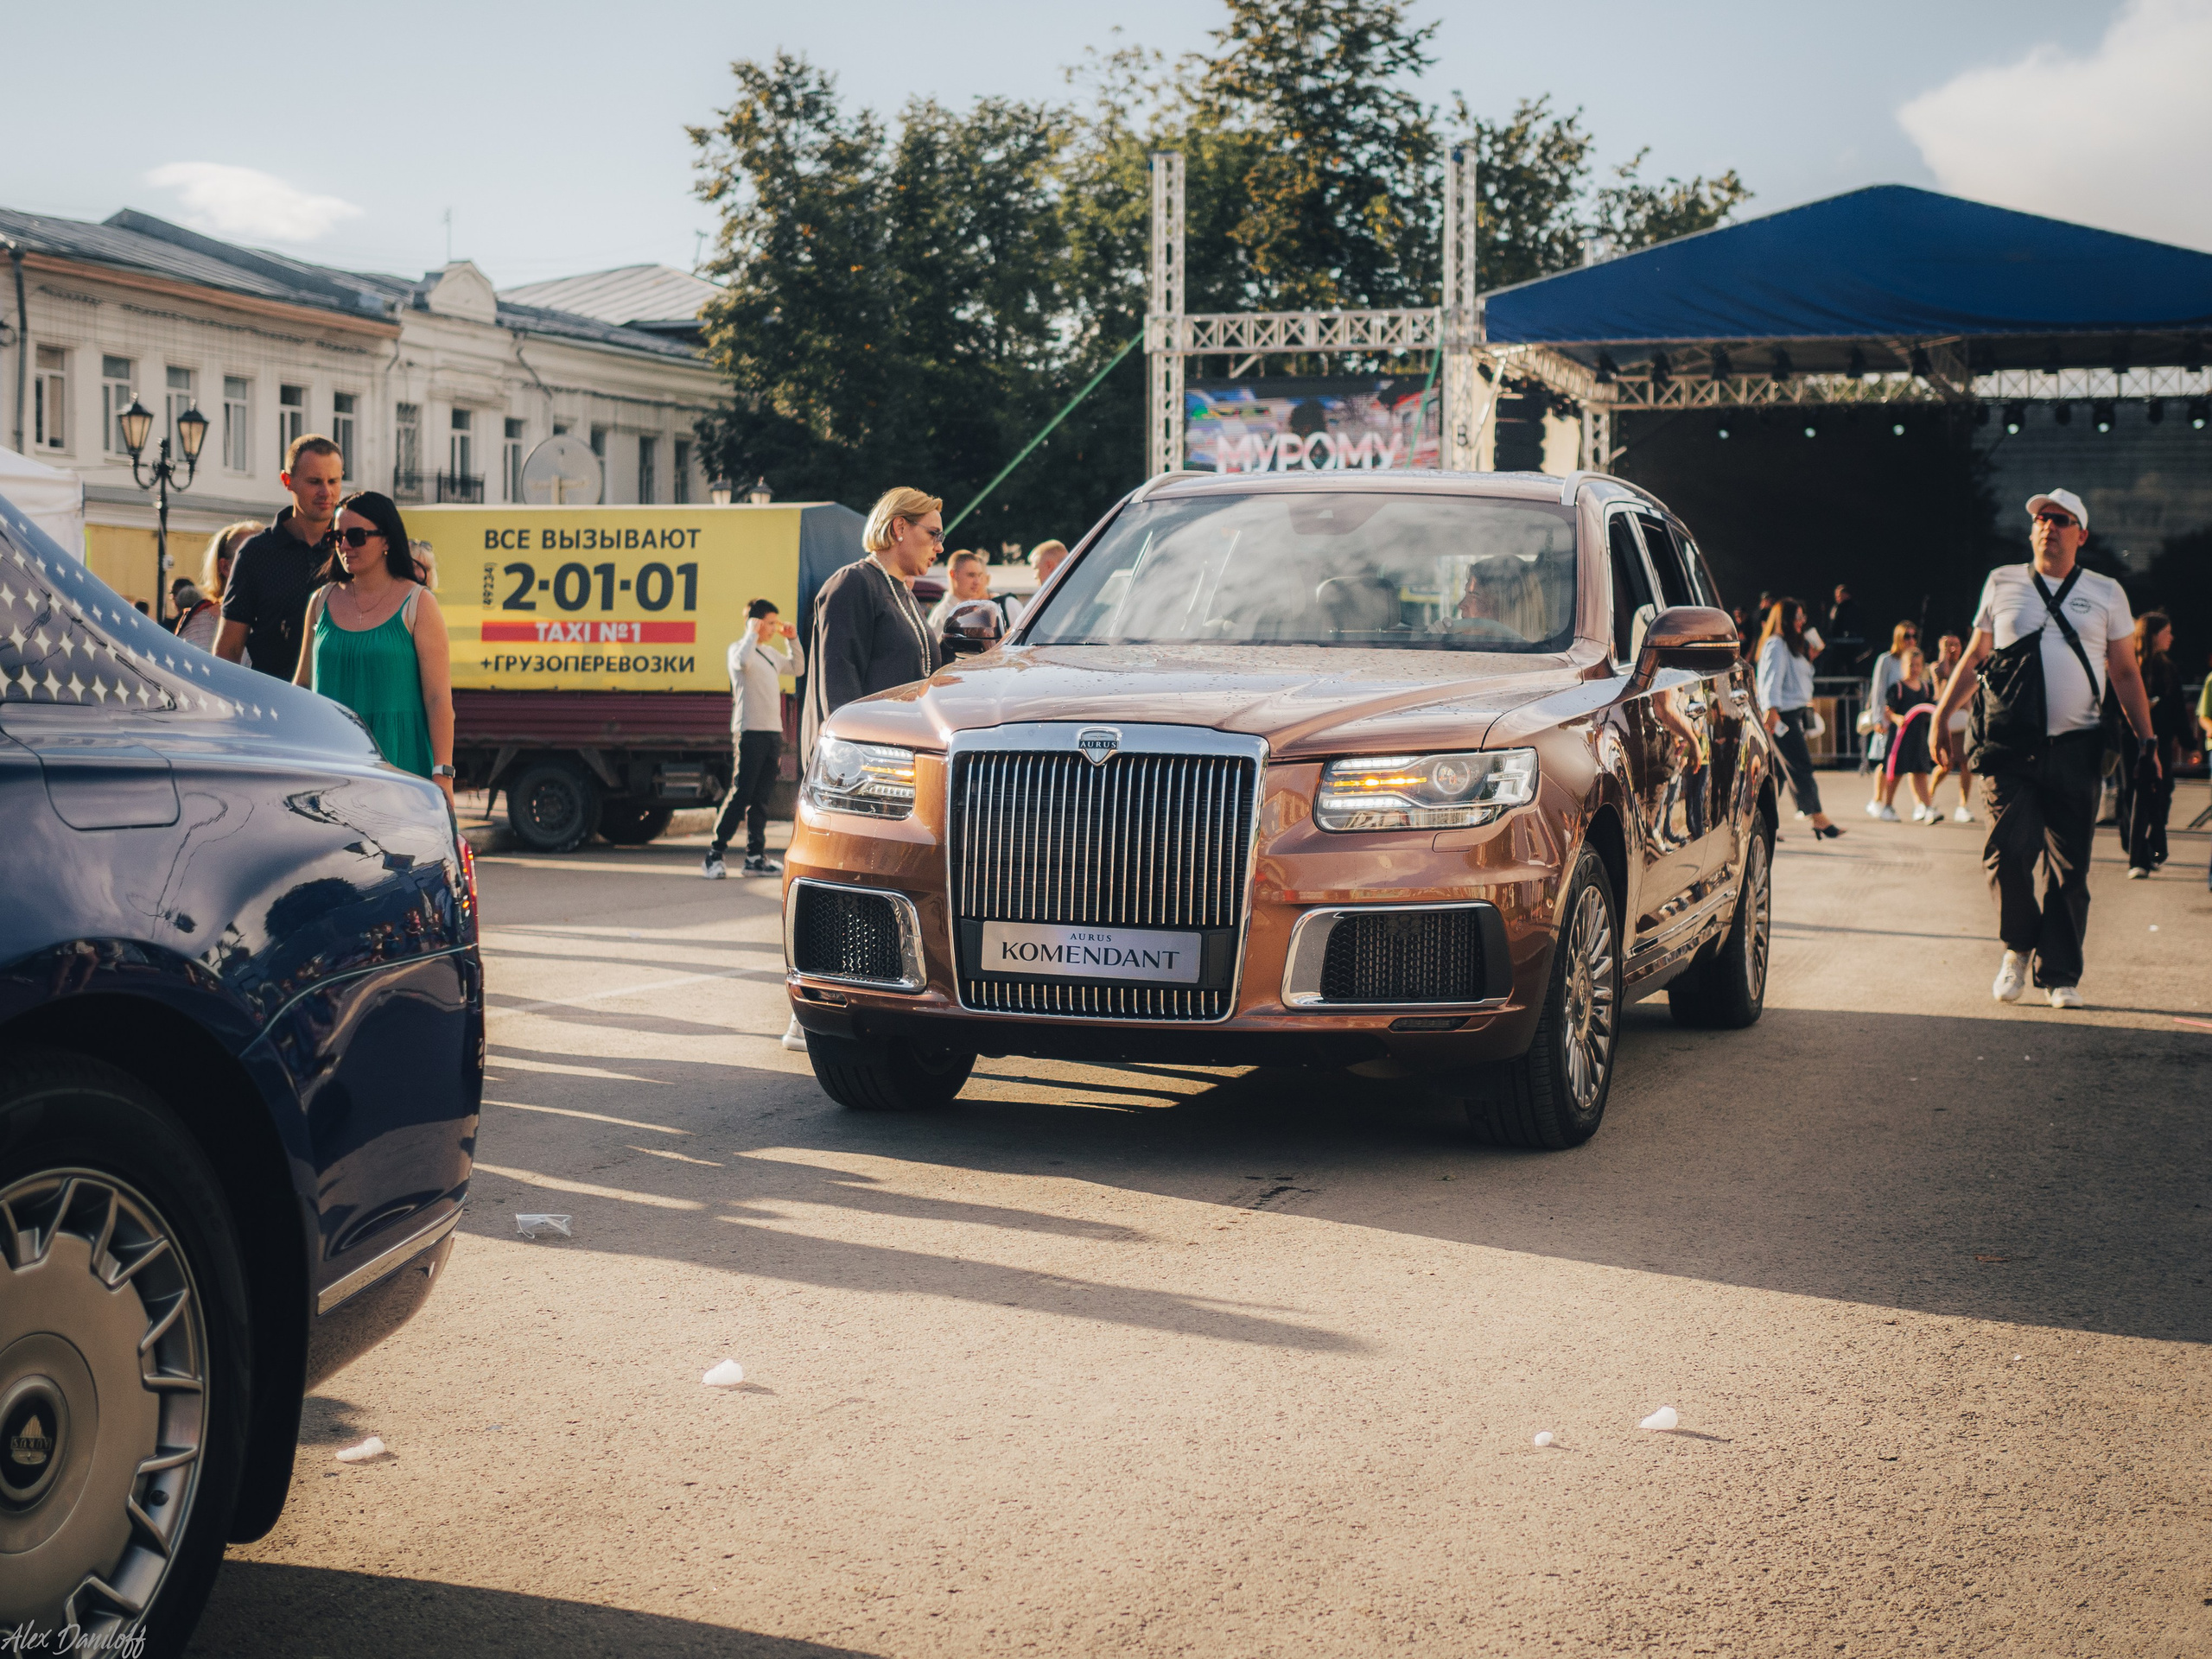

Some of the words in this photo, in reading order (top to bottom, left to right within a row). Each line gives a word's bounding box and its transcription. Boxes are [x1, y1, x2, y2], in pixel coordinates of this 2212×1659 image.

[1216, 431, 1402, 474] МУРОМУ
[484, 529, 531, 550] ВСЕ
[541, 529, 702, 550] ВЫЗЫВАЮТ
[535, 622, 591, 643] TAXI
[480, 655, 696, 673] +ГРУЗОПЕРЕВОЗКИ
[1070, 932, 1112, 942] AURUS
[1001, 941, 1180, 970] KOMENDANT
[13, 1437, 50, 1449] AURUS
